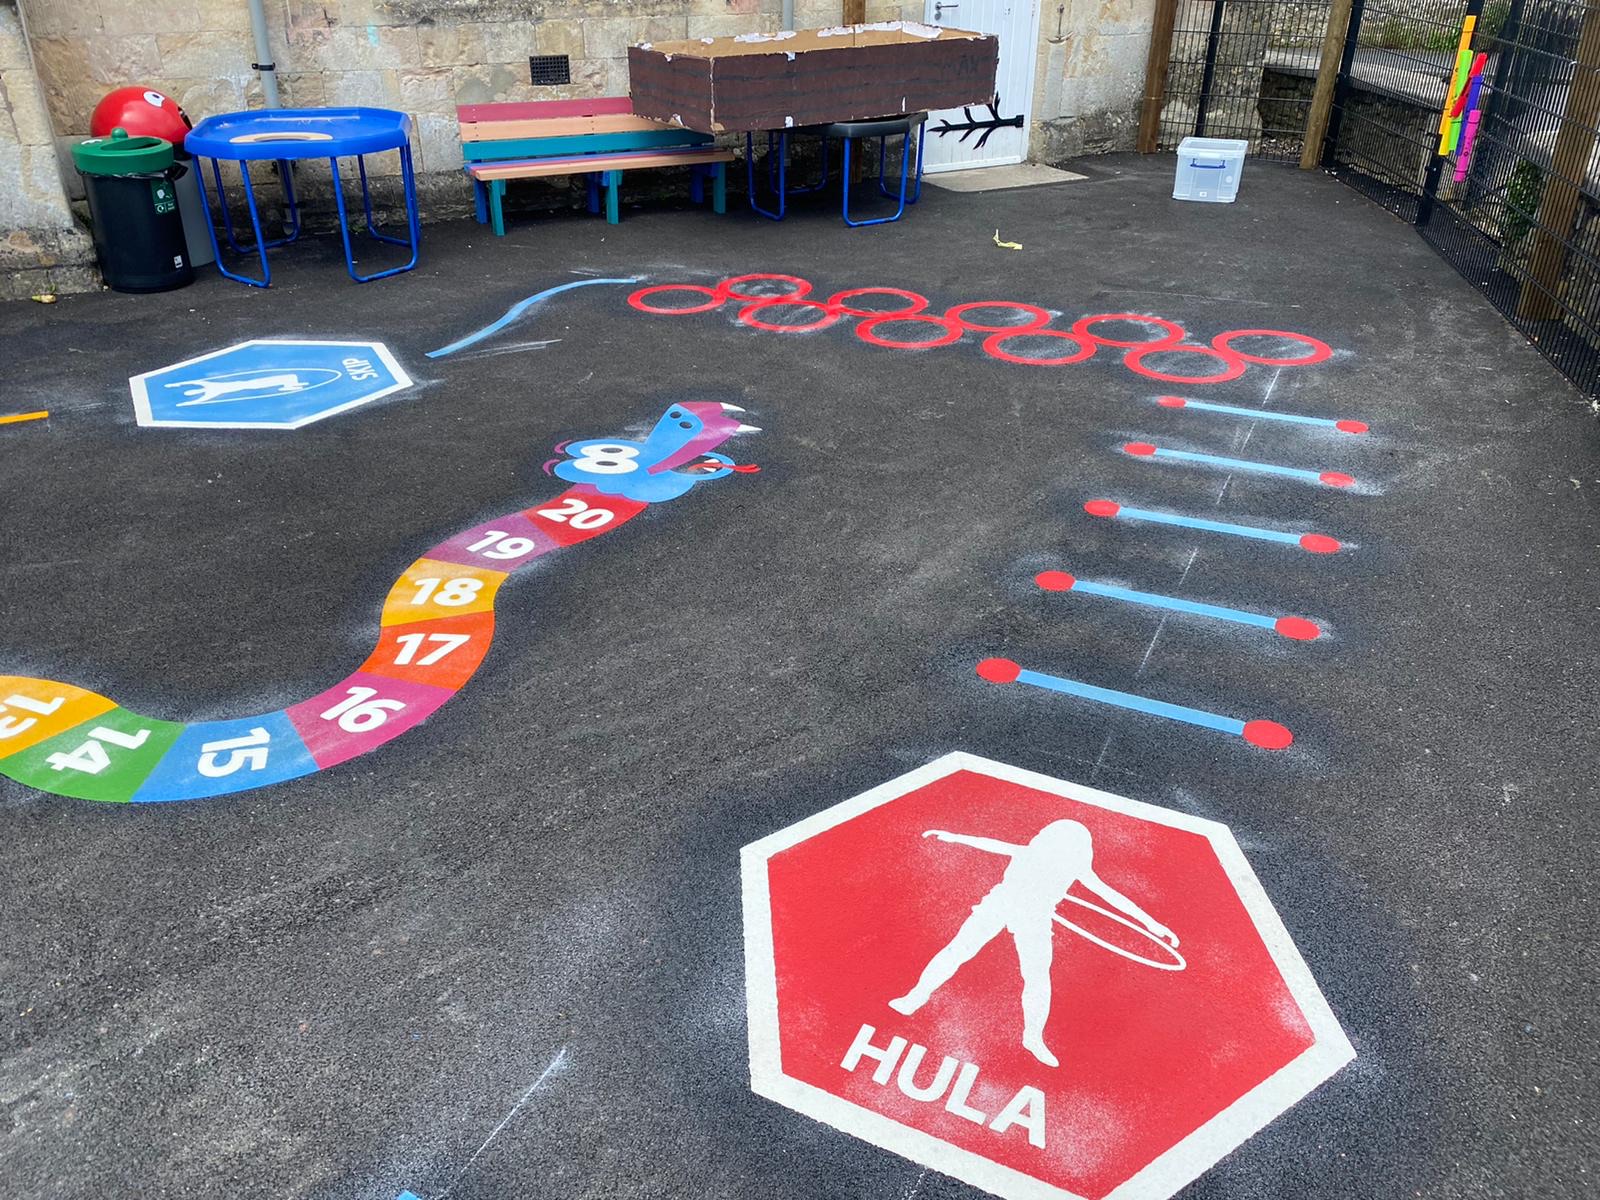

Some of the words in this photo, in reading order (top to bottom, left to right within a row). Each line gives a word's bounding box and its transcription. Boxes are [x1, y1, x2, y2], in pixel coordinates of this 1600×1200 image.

[343, 357, 379, 381] SKIP
[537, 498, 615, 530] 20
[465, 530, 535, 560] 19
[411, 577, 484, 607] 18
[394, 633, 471, 666] 17
[0, 694, 66, 740] 13
[319, 686, 407, 733] 16
[45, 726, 152, 775] 14
[197, 727, 271, 778] 15
[840, 1023, 1047, 1150] HULA
